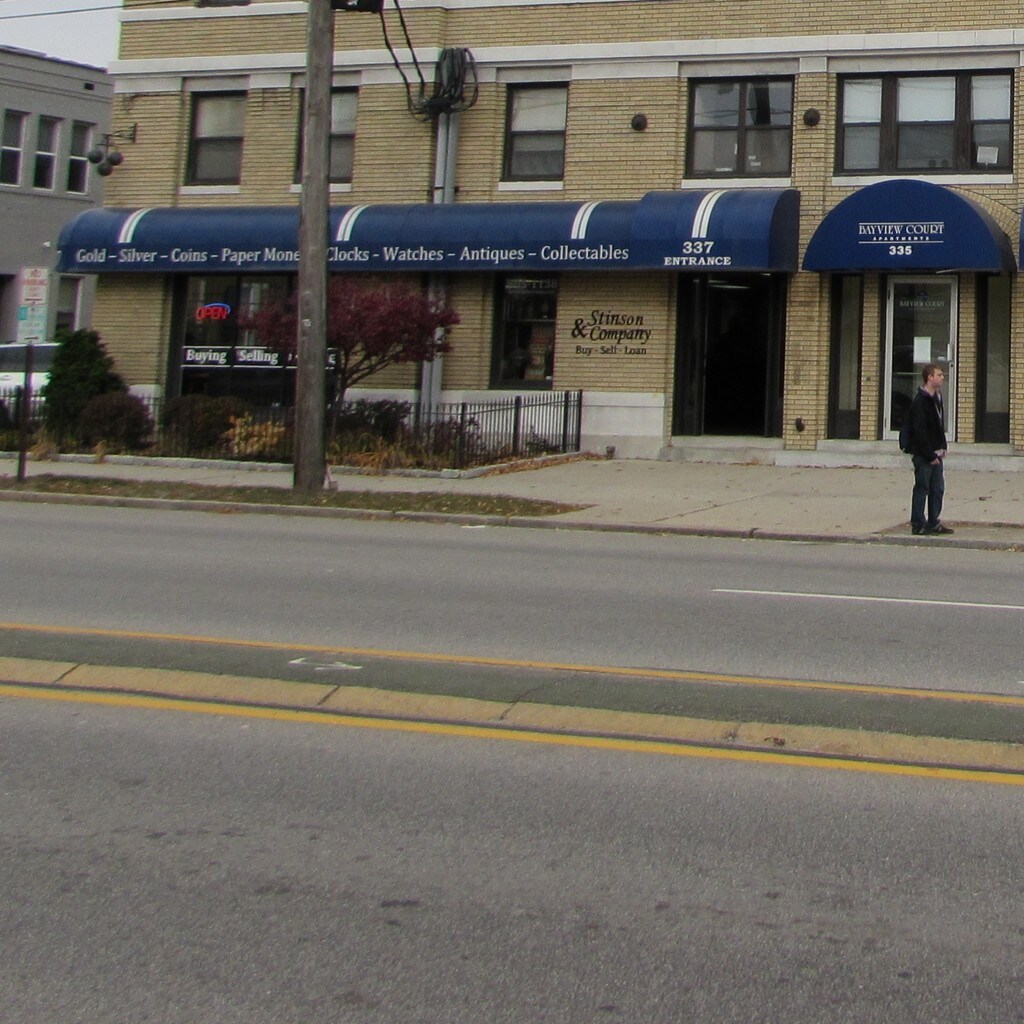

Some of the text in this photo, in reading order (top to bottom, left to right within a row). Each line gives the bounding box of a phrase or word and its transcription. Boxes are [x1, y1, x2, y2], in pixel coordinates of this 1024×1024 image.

[859, 224, 944, 235] BAYVIEW COURT
[682, 241, 715, 254] 337
[889, 246, 912, 255] 335
[76, 248, 106, 263] Gold
[118, 248, 157, 263] Silver
[171, 248, 207, 262] Coins
[222, 248, 261, 266] Paper
[264, 247, 300, 262] Mone
[327, 246, 370, 261] Clocks
[383, 247, 444, 262] Watches
[460, 246, 525, 265] Antiques
[541, 245, 629, 261] Collectables
[664, 257, 731, 265] ENTRANCE
[196, 306, 228, 320] OPEN
[587, 310, 644, 326] Stinson
[571, 318, 651, 344] & Company
[186, 349, 227, 364] Buying
[238, 349, 279, 365] Selling
[575, 345, 593, 356] Buy
[600, 345, 617, 355] Sell
[624, 346, 647, 355] Loan
